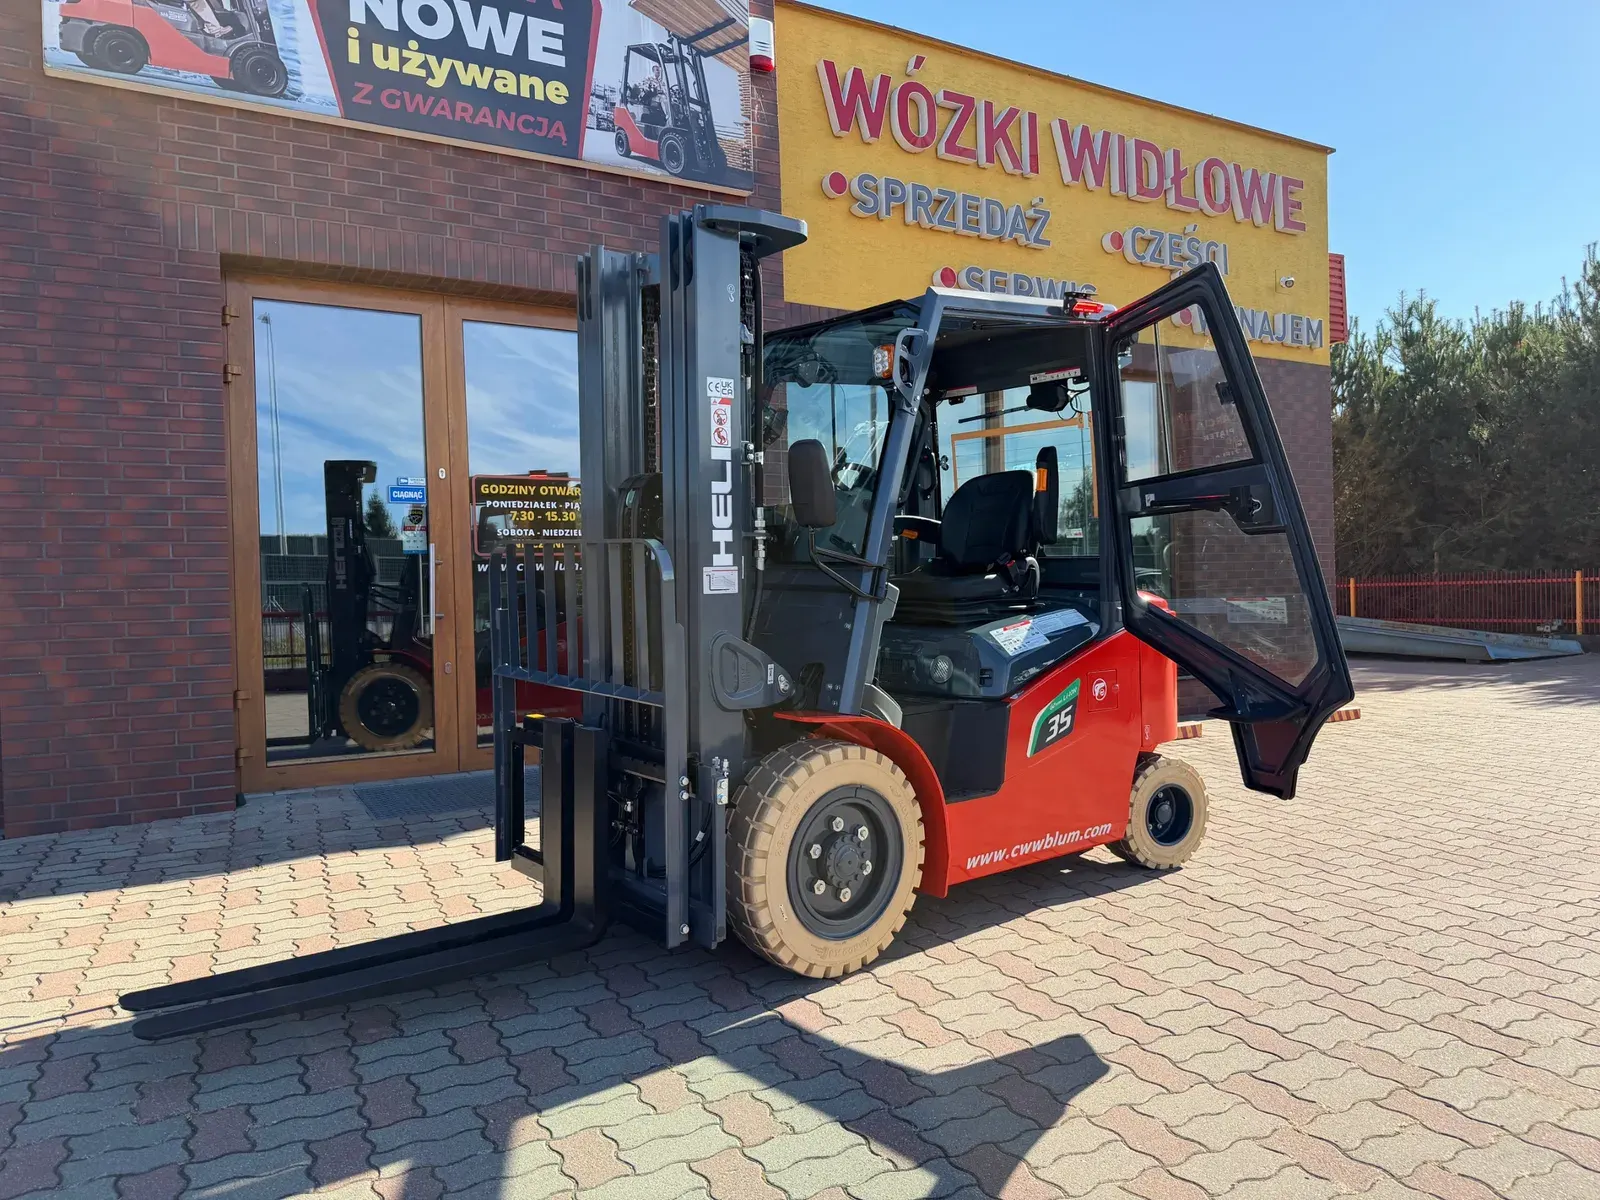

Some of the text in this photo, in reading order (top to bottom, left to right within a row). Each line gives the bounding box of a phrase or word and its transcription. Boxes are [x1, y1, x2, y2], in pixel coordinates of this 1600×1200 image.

[349, 0, 566, 67] NOWE
[347, 27, 569, 105] i używane
[352, 82, 567, 146] Z GWARANCJĄ
[816, 55, 1306, 234] WÓZKI WIDŁOWE
[849, 173, 1052, 249] SPRZEDAŻ
[392, 489, 423, 500] CIĄGNĄĆ
[480, 484, 536, 495] GODZINY
[486, 500, 557, 509] PONIEDZIAŁEK
[564, 501, 582, 511] PIĄ
[711, 447, 733, 566] HELI
[497, 528, 535, 537] SOBOTA
[510, 510, 534, 521] 7.30
[545, 511, 576, 521] 15.30
[1045, 705, 1073, 743] 35
[966, 823, 1112, 870] www.cwwblum.com
